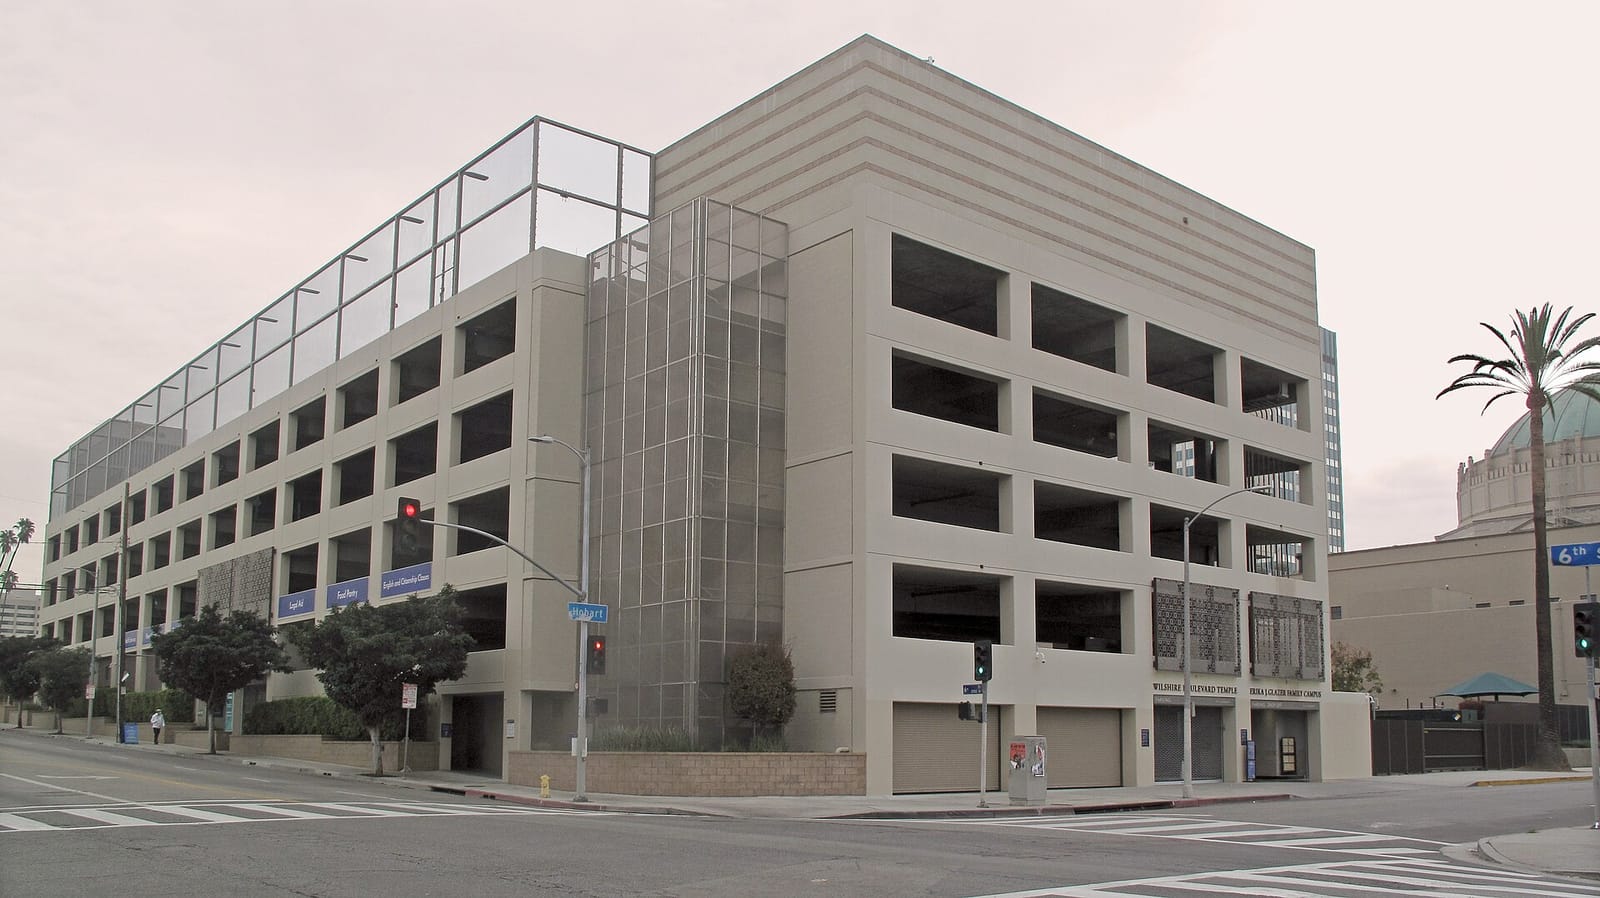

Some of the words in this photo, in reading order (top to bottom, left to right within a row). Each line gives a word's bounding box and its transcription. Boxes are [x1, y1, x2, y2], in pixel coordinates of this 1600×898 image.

[1559, 546, 1586, 564] 6th
[336, 589, 347, 600] Food
[347, 588, 359, 600] Pantry
[572, 607, 603, 618] Hobart
[1153, 682, 1182, 692] WILSHIRE
[1183, 684, 1216, 694] ULEVARD
[1217, 686, 1238, 695] TEMPLE
[1250, 687, 1264, 696] ERIKA
[1268, 688, 1286, 697] GLAZER
[1287, 689, 1303, 698] FAMILY
[1304, 690, 1322, 698] CAMPUS
